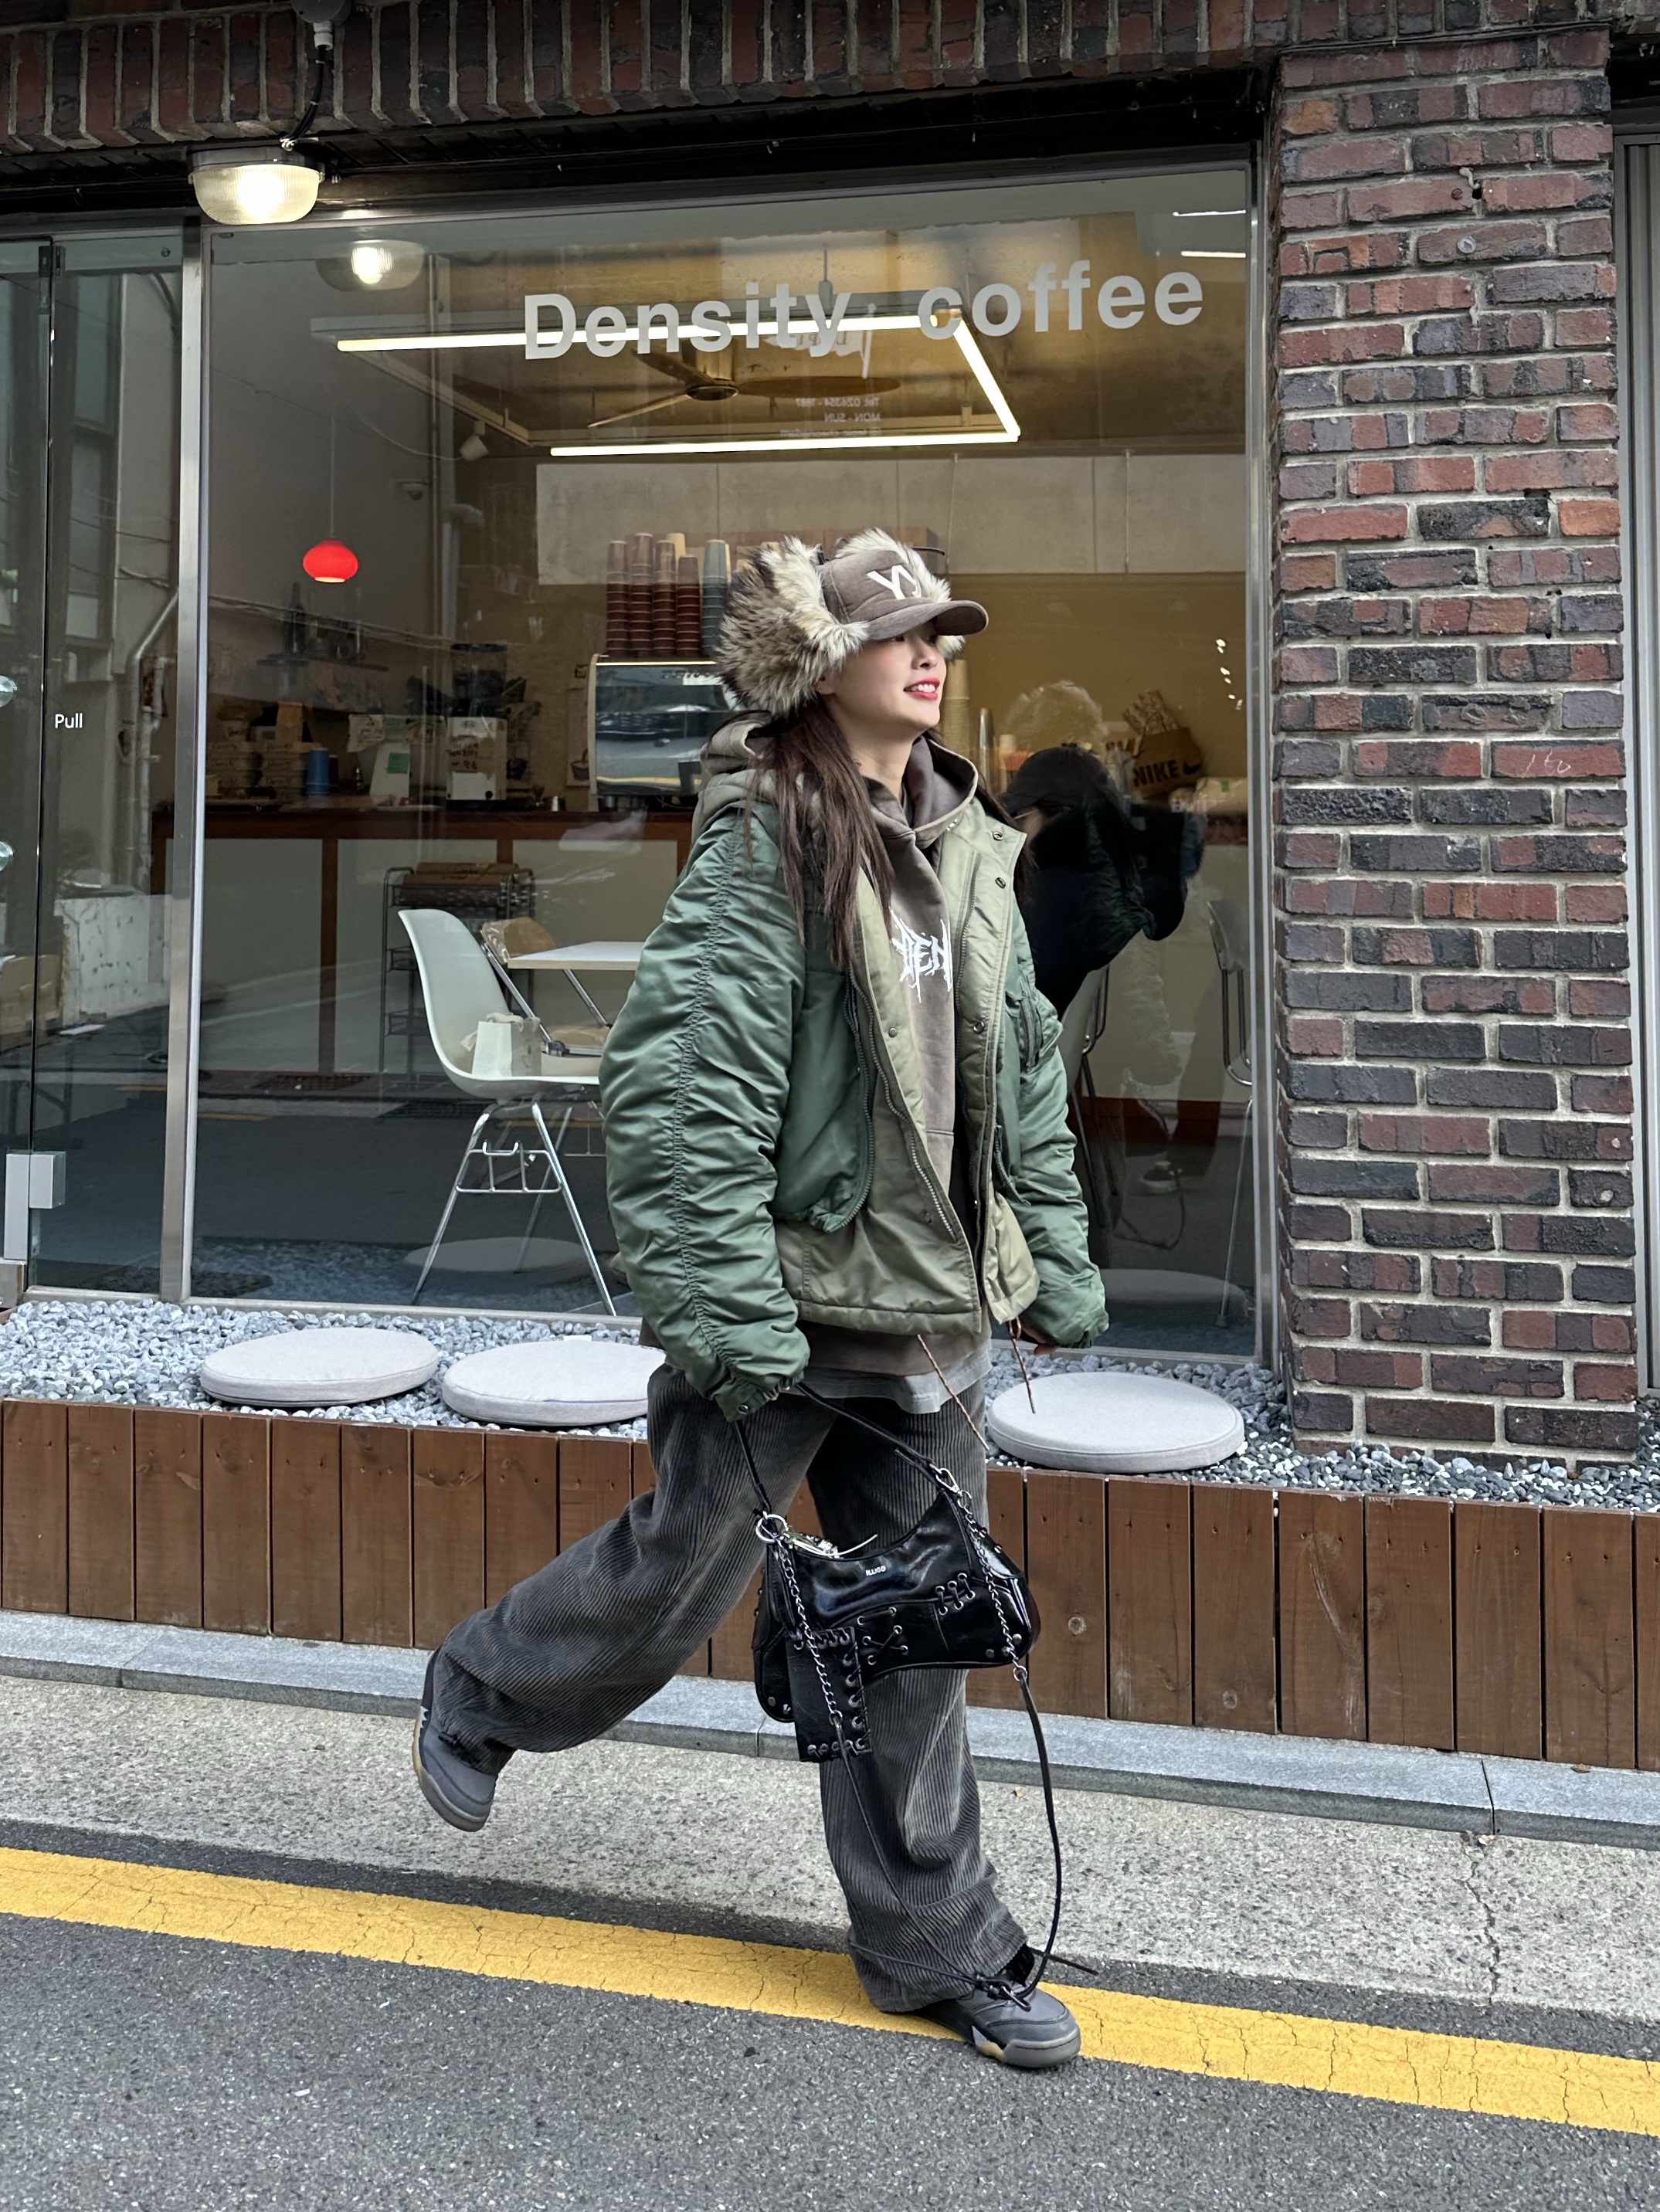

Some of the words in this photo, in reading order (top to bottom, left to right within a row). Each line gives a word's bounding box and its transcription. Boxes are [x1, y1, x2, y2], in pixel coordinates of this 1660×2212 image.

[523, 282, 852, 361] Density
[918, 261, 1203, 339] coffee
[55, 712, 83, 729] Pull
[1133, 759, 1180, 787] NIKE
